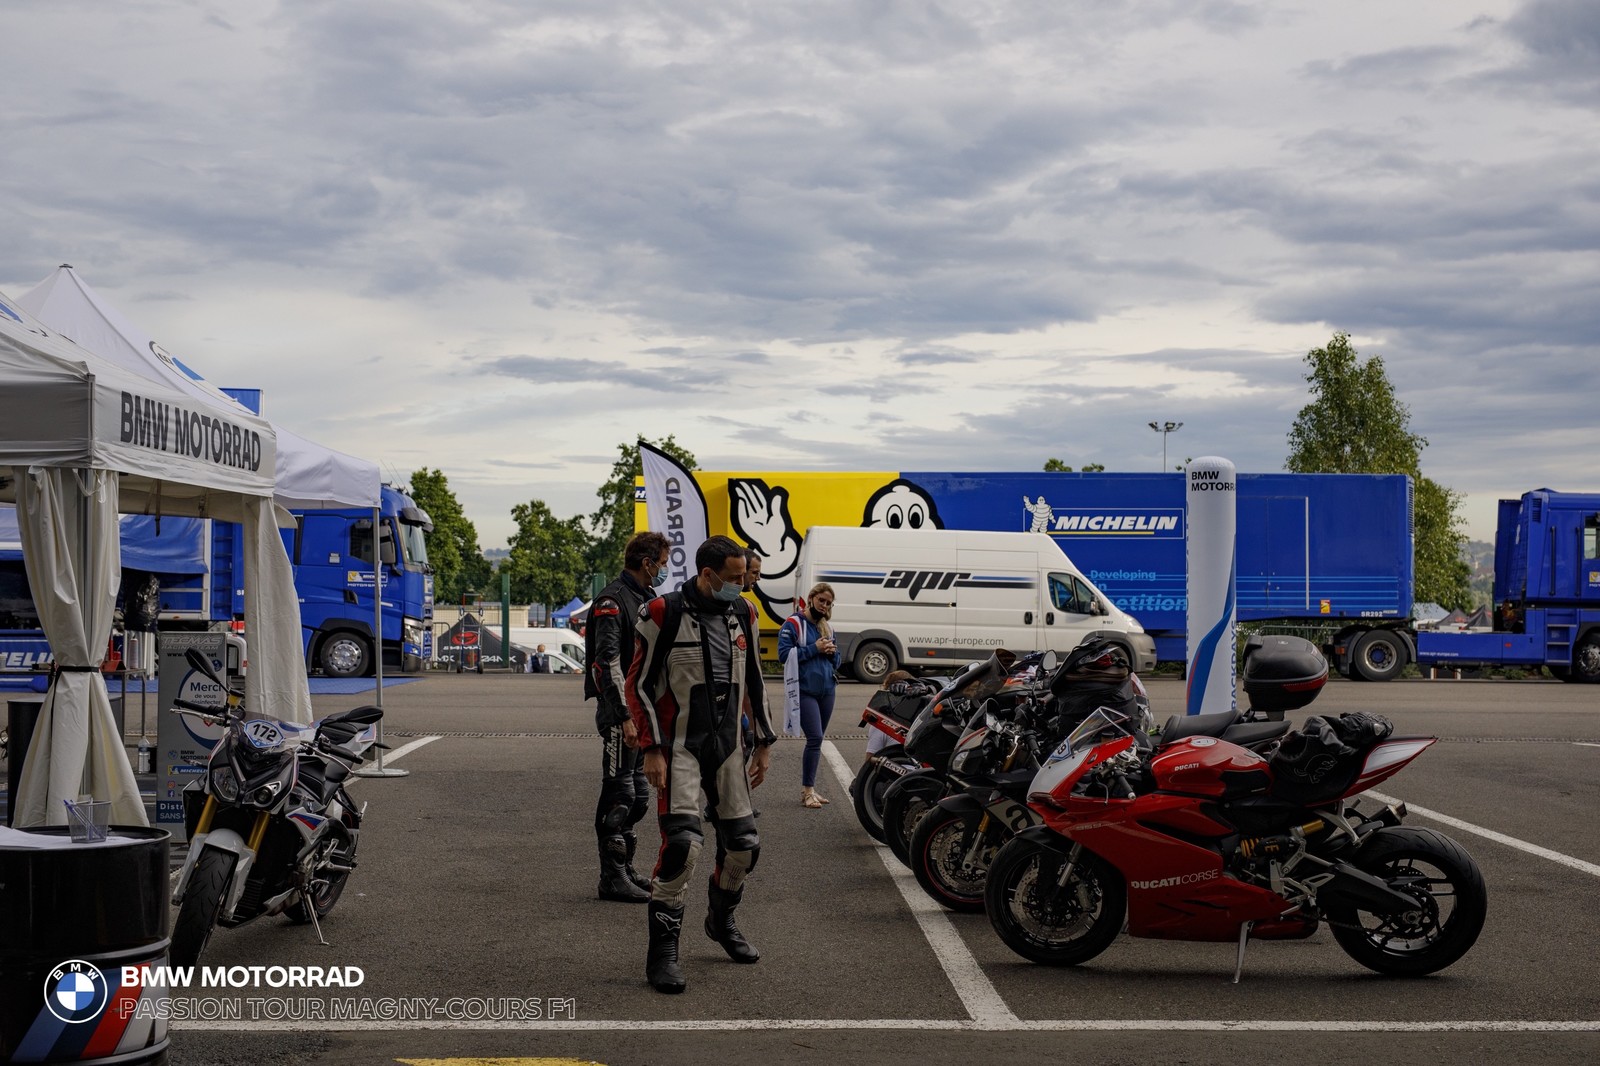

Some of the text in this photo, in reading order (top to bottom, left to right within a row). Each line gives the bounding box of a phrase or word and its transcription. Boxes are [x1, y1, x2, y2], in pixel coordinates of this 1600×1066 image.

[120, 390, 261, 472] BMW MOTORRAD
[1192, 471, 1219, 480] BMW
[1054, 516, 1178, 530] MICHELIN
[1090, 570, 1156, 581] Developing
[883, 570, 971, 601] apr
[1110, 594, 1187, 611] etition
[909, 637, 1004, 647] www.apr-europe.com
[190, 682, 222, 691] Merci
[253, 723, 277, 742] 172
[1174, 762, 1199, 772] DUCATI
[1130, 869, 1219, 889] DUCATI CORSE
